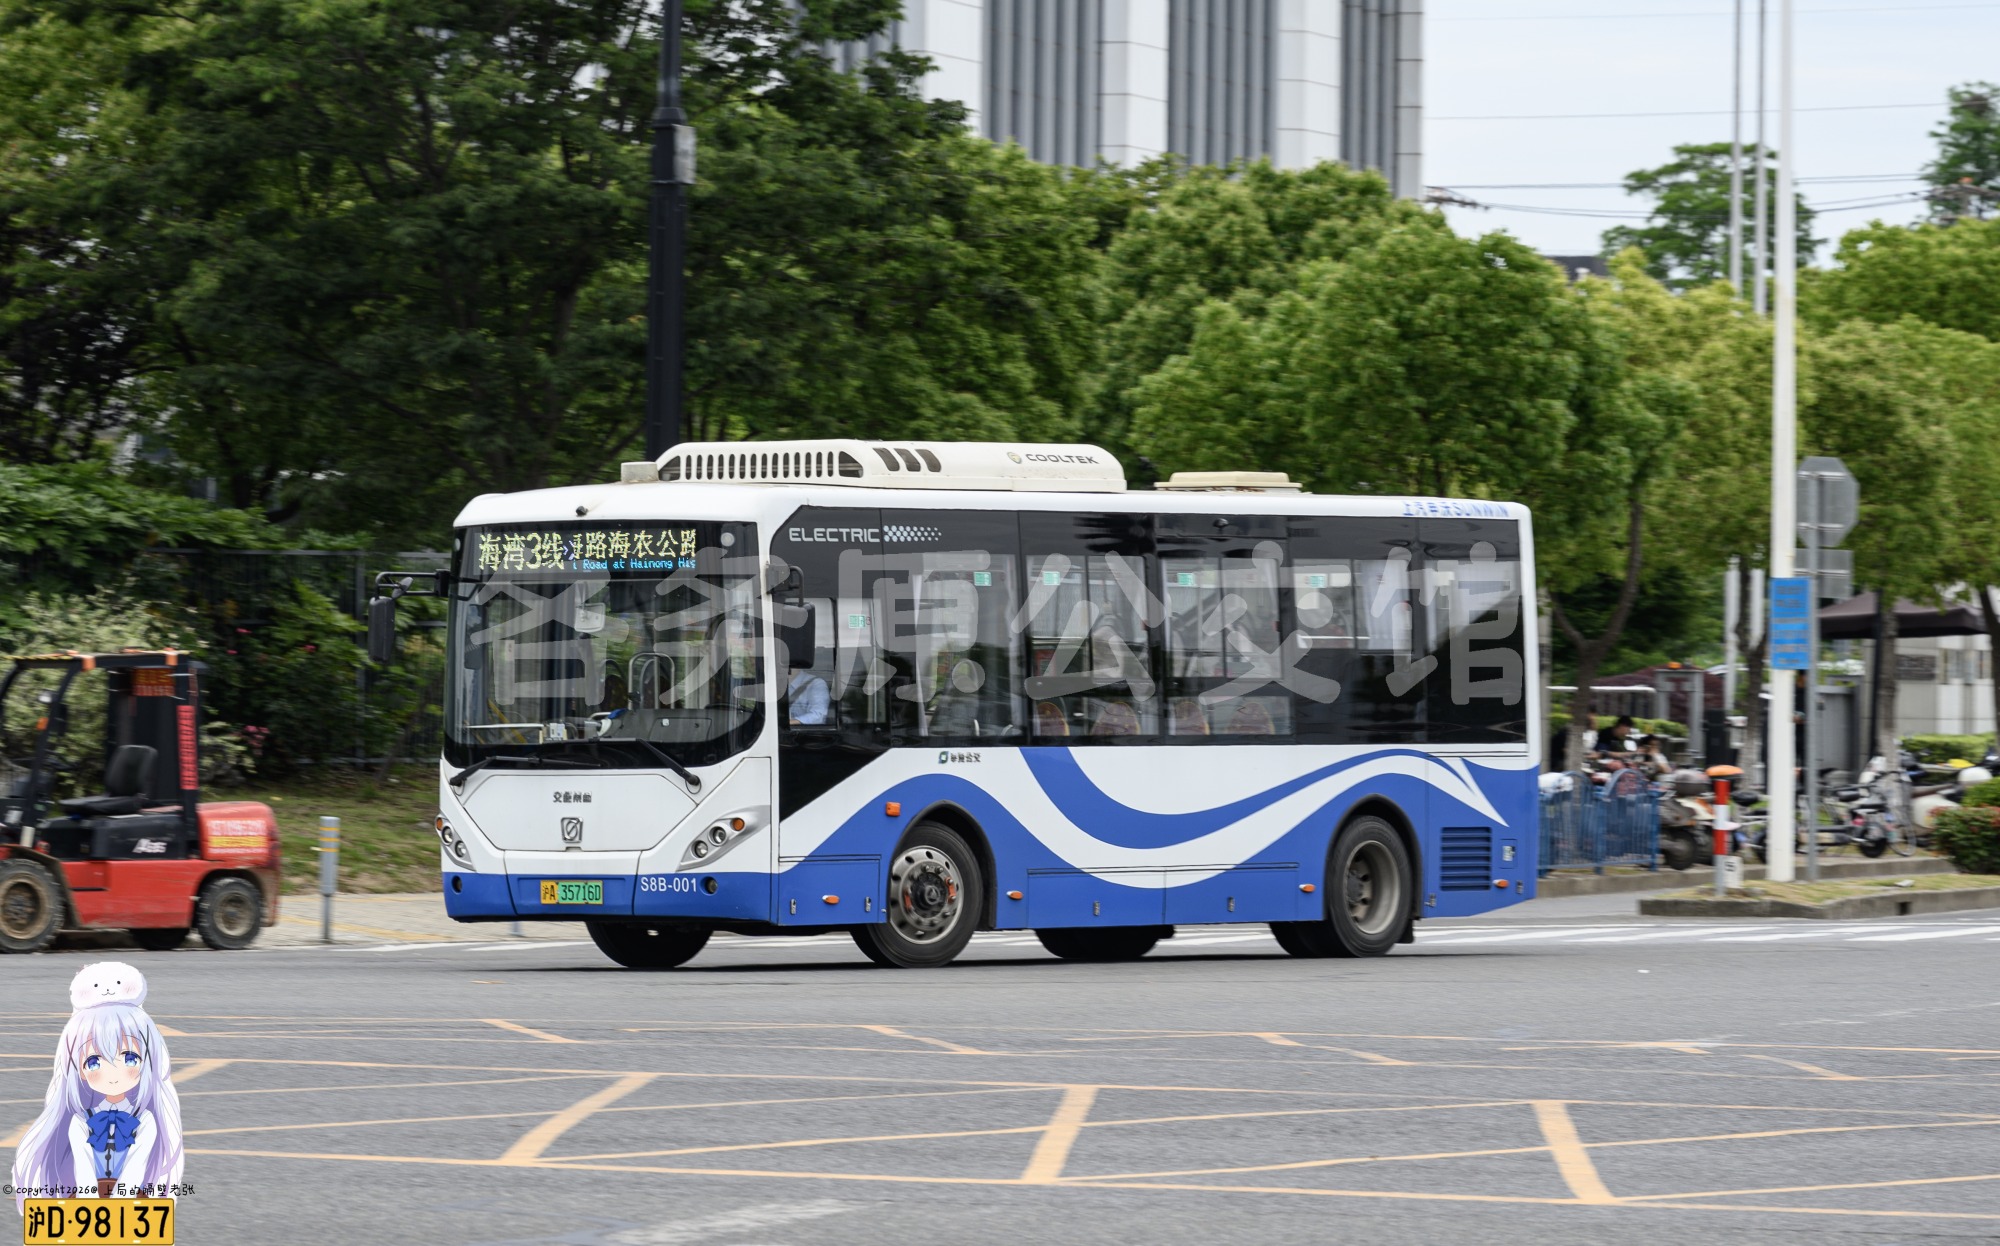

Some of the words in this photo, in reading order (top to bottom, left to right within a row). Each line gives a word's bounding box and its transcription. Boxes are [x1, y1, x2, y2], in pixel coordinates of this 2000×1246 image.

[1025, 453, 1100, 464] COOLTEK
[788, 527, 880, 543] ELECTRIC
[478, 532, 564, 571] 海湾3线
[582, 558, 608, 570] Road
[612, 558, 625, 569] at
[630, 557, 674, 570] Hainong
[640, 876, 697, 893] S8B-001
